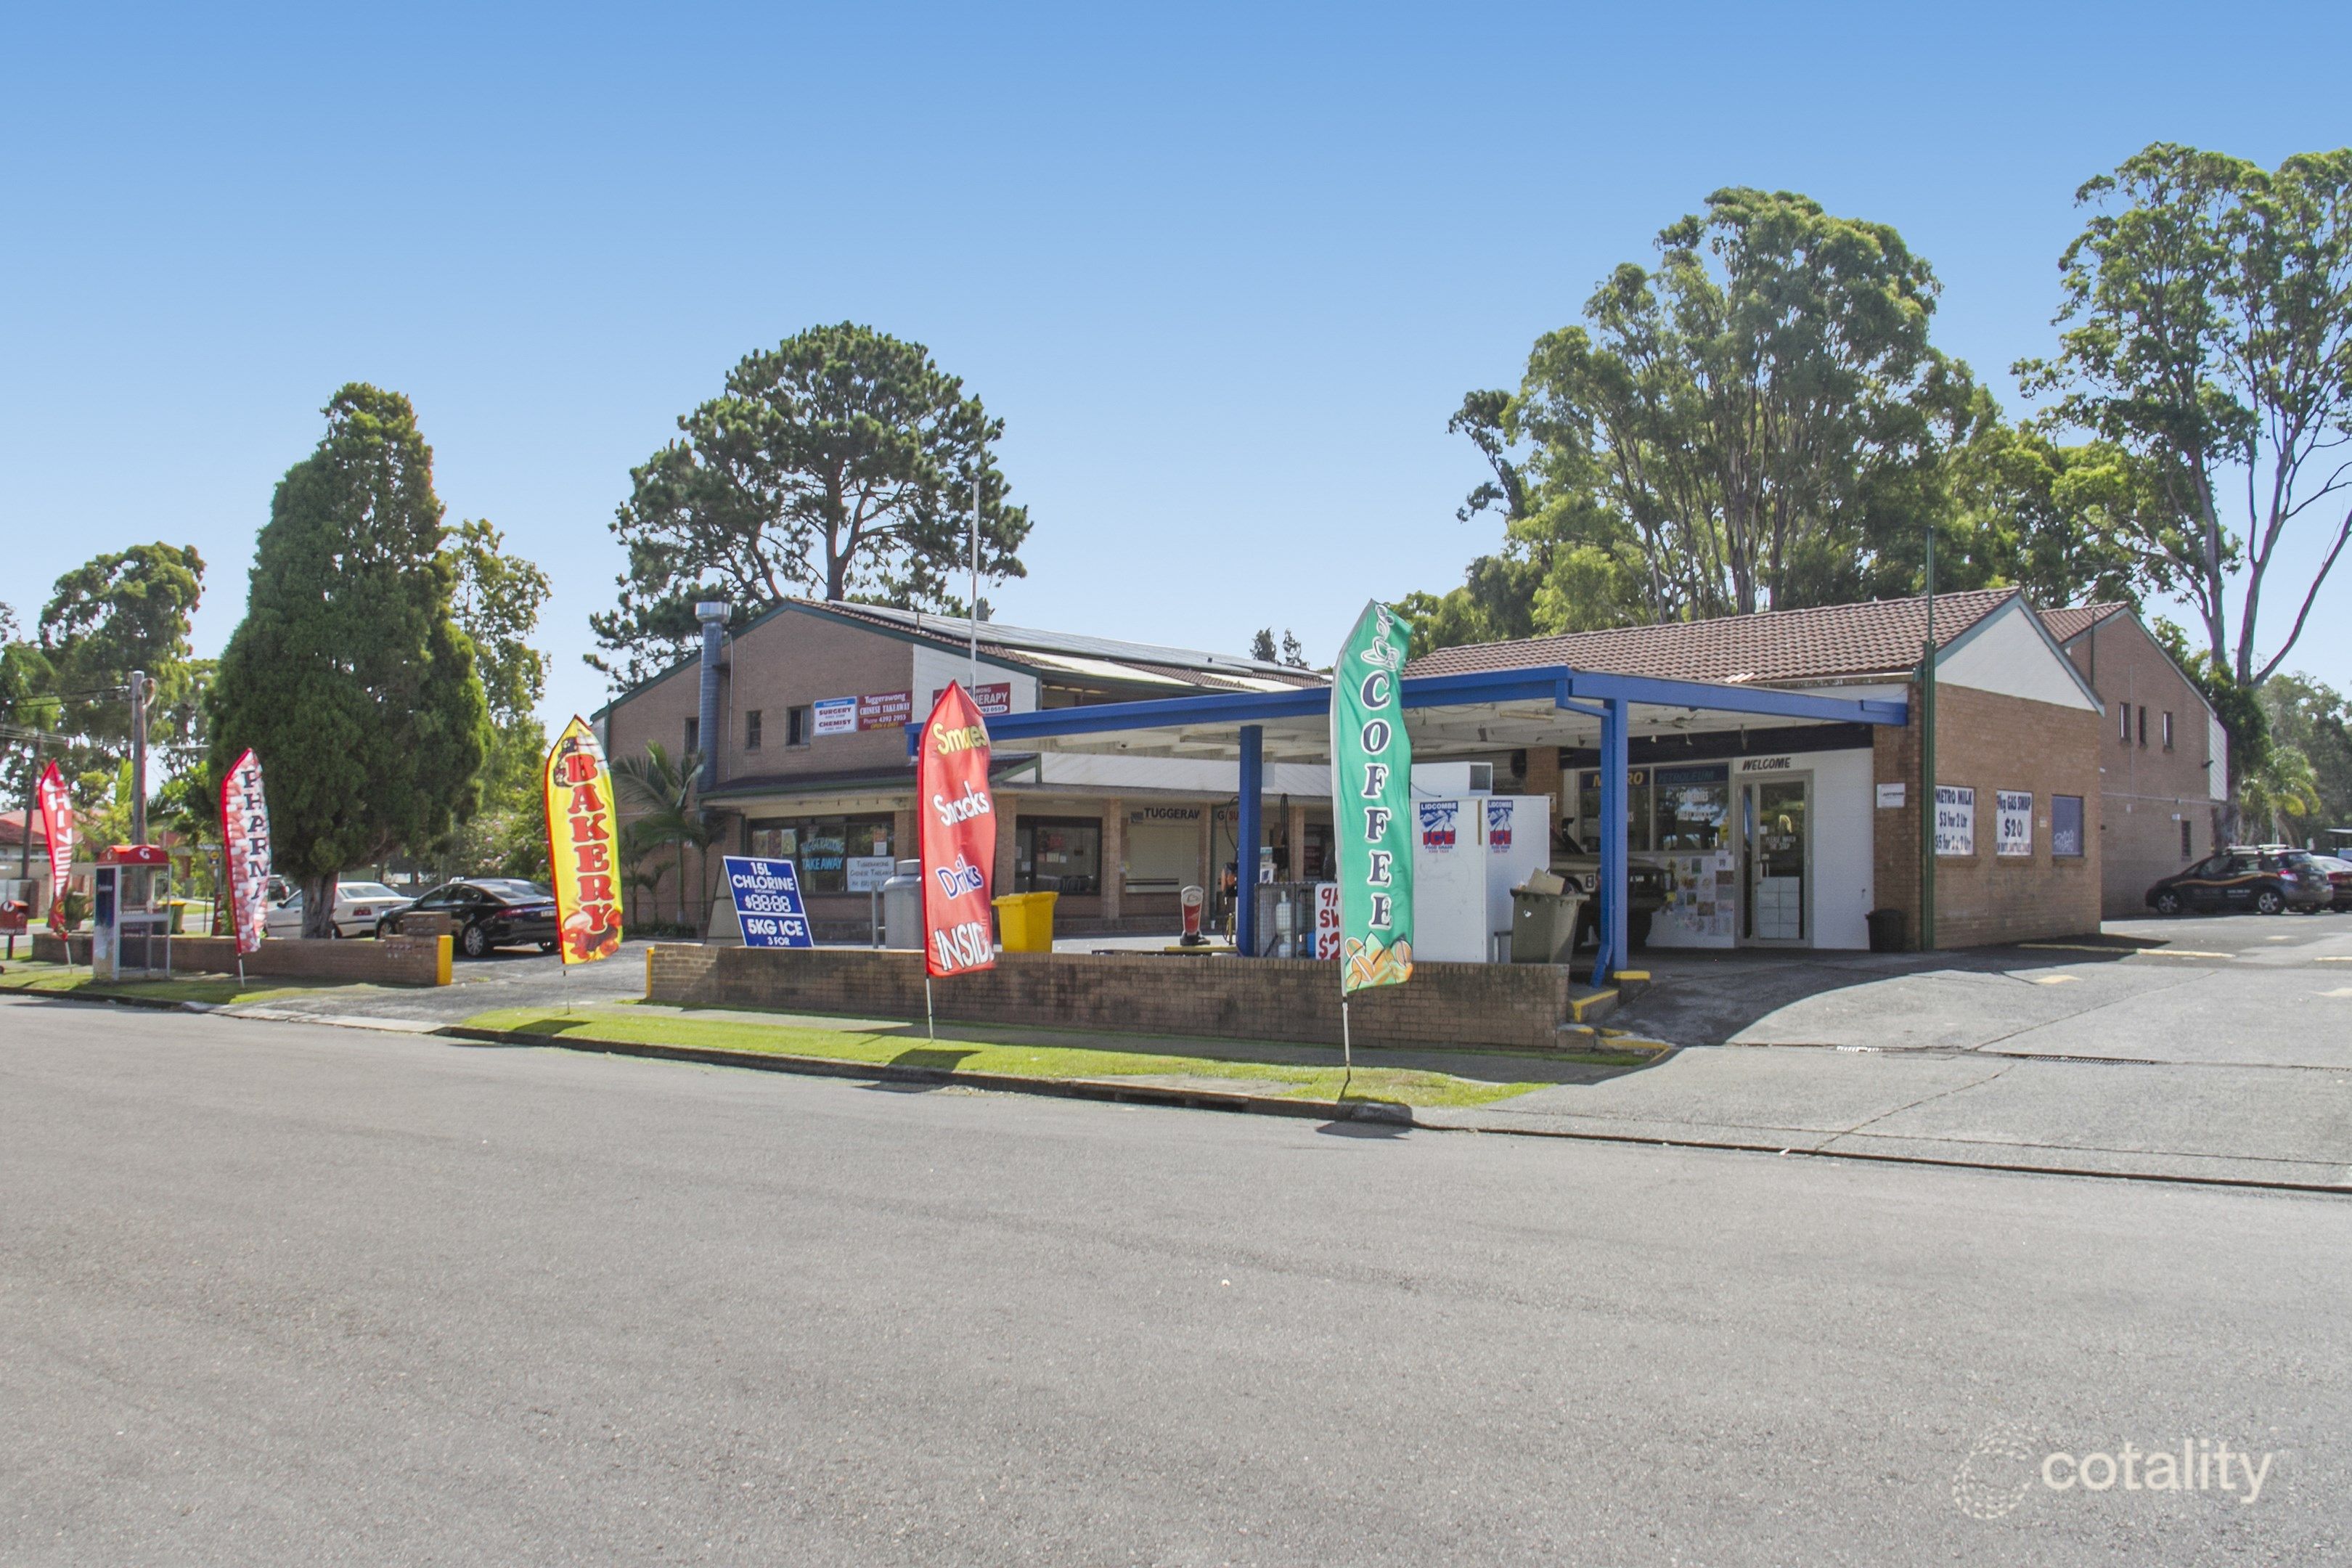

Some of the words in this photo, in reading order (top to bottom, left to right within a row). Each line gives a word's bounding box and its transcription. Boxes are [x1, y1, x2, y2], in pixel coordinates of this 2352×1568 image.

[865, 693, 906, 705] Tuggerawong
[974, 691, 1008, 705] HERAPY
[819, 707, 852, 716] SURGERY
[883, 702, 910, 713] TAKEAWAY
[1741, 757, 1792, 771] WELCOME
[1593, 772, 1643, 787] MRO
[933, 780, 990, 827] Snacks
[1360, 669, 1394, 930] COFFEE
[1935, 788, 1956, 804] METRO
[1958, 789, 1972, 805] MILK
[2007, 794, 2017, 810] GAS
[2017, 796, 2030, 811] SWAP
[1939, 811, 1946, 828] $3
[1956, 812, 1960, 828] 2
[2004, 817, 2022, 838] $20
[565, 753, 616, 933] BAKERY
[1423, 830, 1455, 846] ICE
[750, 862, 772, 875] 15L
[732, 874, 795, 891] CHLORINE
[747, 918, 777, 935] 5KG
[778, 920, 804, 936] ICE
[767, 936, 773, 946] 3
[774, 936, 791, 946] FOR
